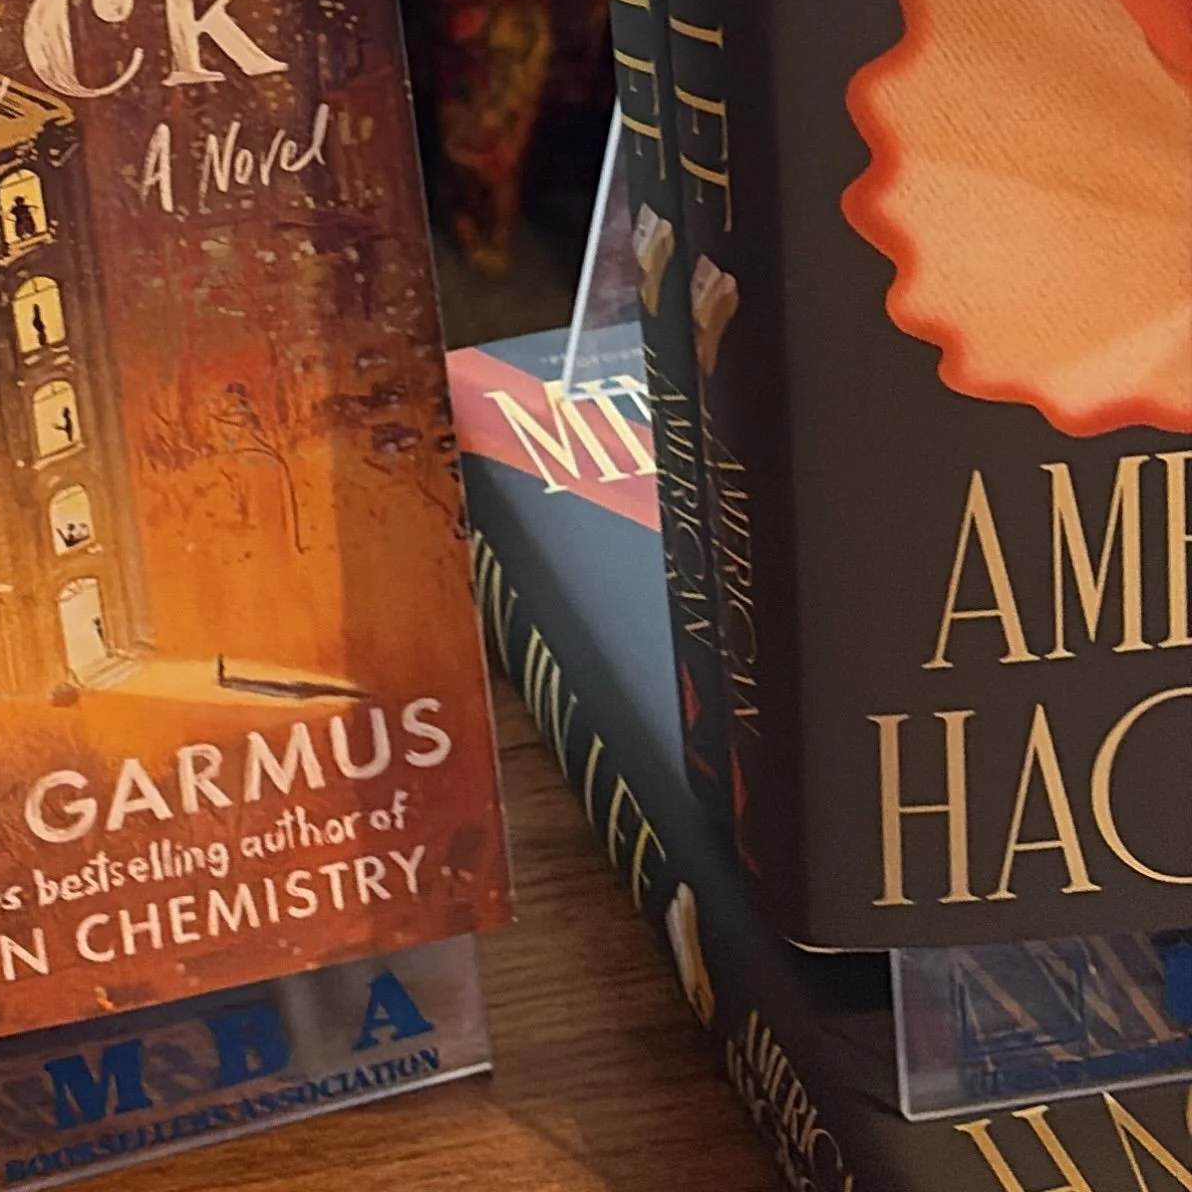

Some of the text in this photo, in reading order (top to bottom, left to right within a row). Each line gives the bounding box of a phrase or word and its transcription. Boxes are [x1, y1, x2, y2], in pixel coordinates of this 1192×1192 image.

[141, 104, 330, 213] A Novel
[24, 696, 453, 844] GARMUS
[33, 839, 231, 906] bestselling
[239, 805, 362, 860] author
[369, 789, 409, 831] of
[74, 844, 428, 964] CHEMISTRY
[236, 1048, 441, 1124] ASSOCIATION
